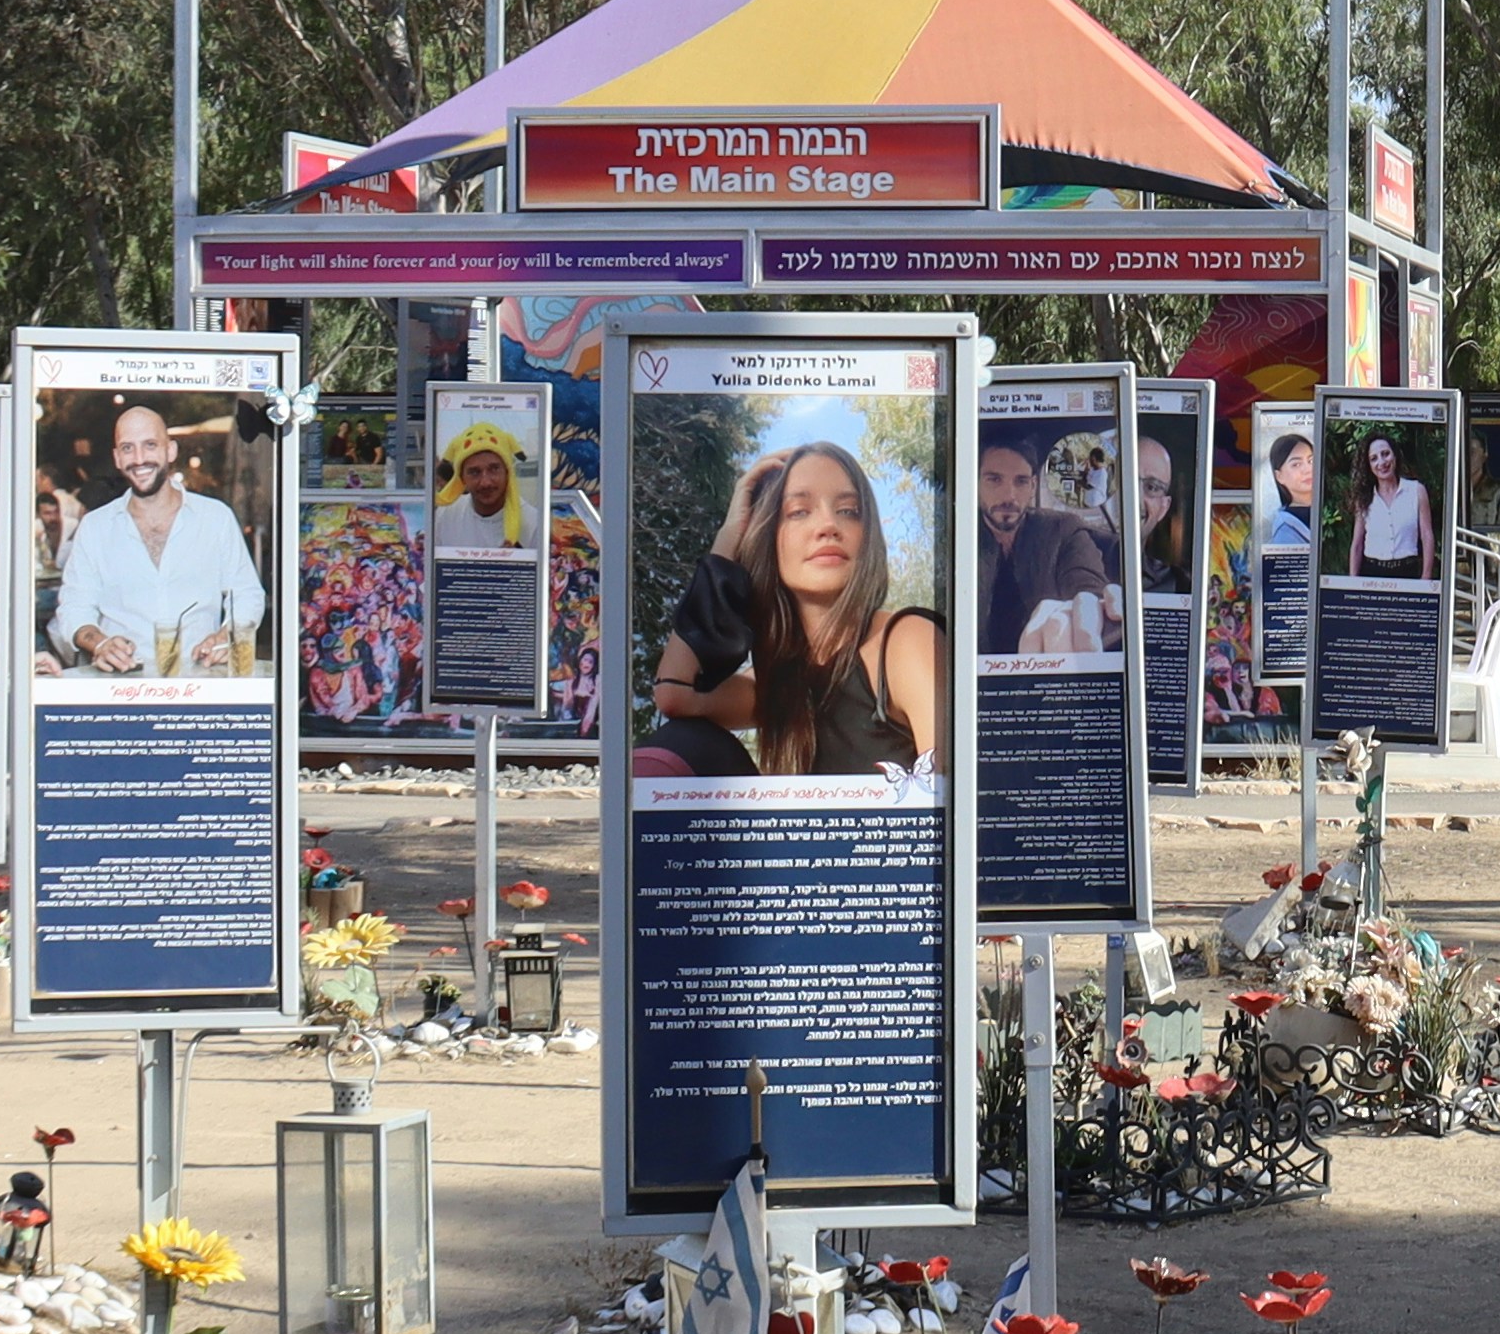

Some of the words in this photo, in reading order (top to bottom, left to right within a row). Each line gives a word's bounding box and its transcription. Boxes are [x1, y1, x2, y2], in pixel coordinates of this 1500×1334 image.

[635, 128, 770, 157] המרכזית
[778, 128, 867, 156] הבמה
[608, 166, 678, 193] The
[690, 166, 776, 193] Main
[788, 165, 895, 199] Stage
[319, 192, 339, 214] The
[215, 254, 257, 269] "Your
[260, 254, 295, 272] light
[299, 253, 325, 268] will
[329, 253, 369, 268] shine
[373, 253, 426, 268] forever
[429, 253, 457, 268] and
[459, 257, 494, 271] your
[496, 252, 520, 271] joy
[523, 252, 550, 267] will
[555, 252, 573, 267] be
[575, 252, 671, 267] remembered
[674, 251, 729, 269] always"
[777, 247, 824, 270] לעד.
[831, 252, 899, 269] שנדמו
[907, 252, 1000, 269] והשמחה
[1006, 252, 1062, 269] האור
[1070, 252, 1101, 269] עם
[1108, 252, 1179, 272] אתכם,
[1186, 252, 1243, 269] נזכור
[1251, 247, 1306, 269] לנצח
[115, 359, 149, 371] נקמולי
[151, 359, 179, 370] ליאור
[182, 361, 195, 370] בר
[731, 354, 765, 368] למאי
[770, 357, 817, 371] דידנקו
[821, 355, 857, 369] יוליה
[99, 372, 123, 383] Bar
[126, 373, 152, 384] Lior
[156, 374, 210, 385] Nakmuli
[710, 372, 751, 387] Yulia
[757, 374, 822, 386] Didenko
[827, 375, 876, 387] Lamai
[1011, 405, 1031, 413] Ben
[1033, 403, 1060, 412] Naim
